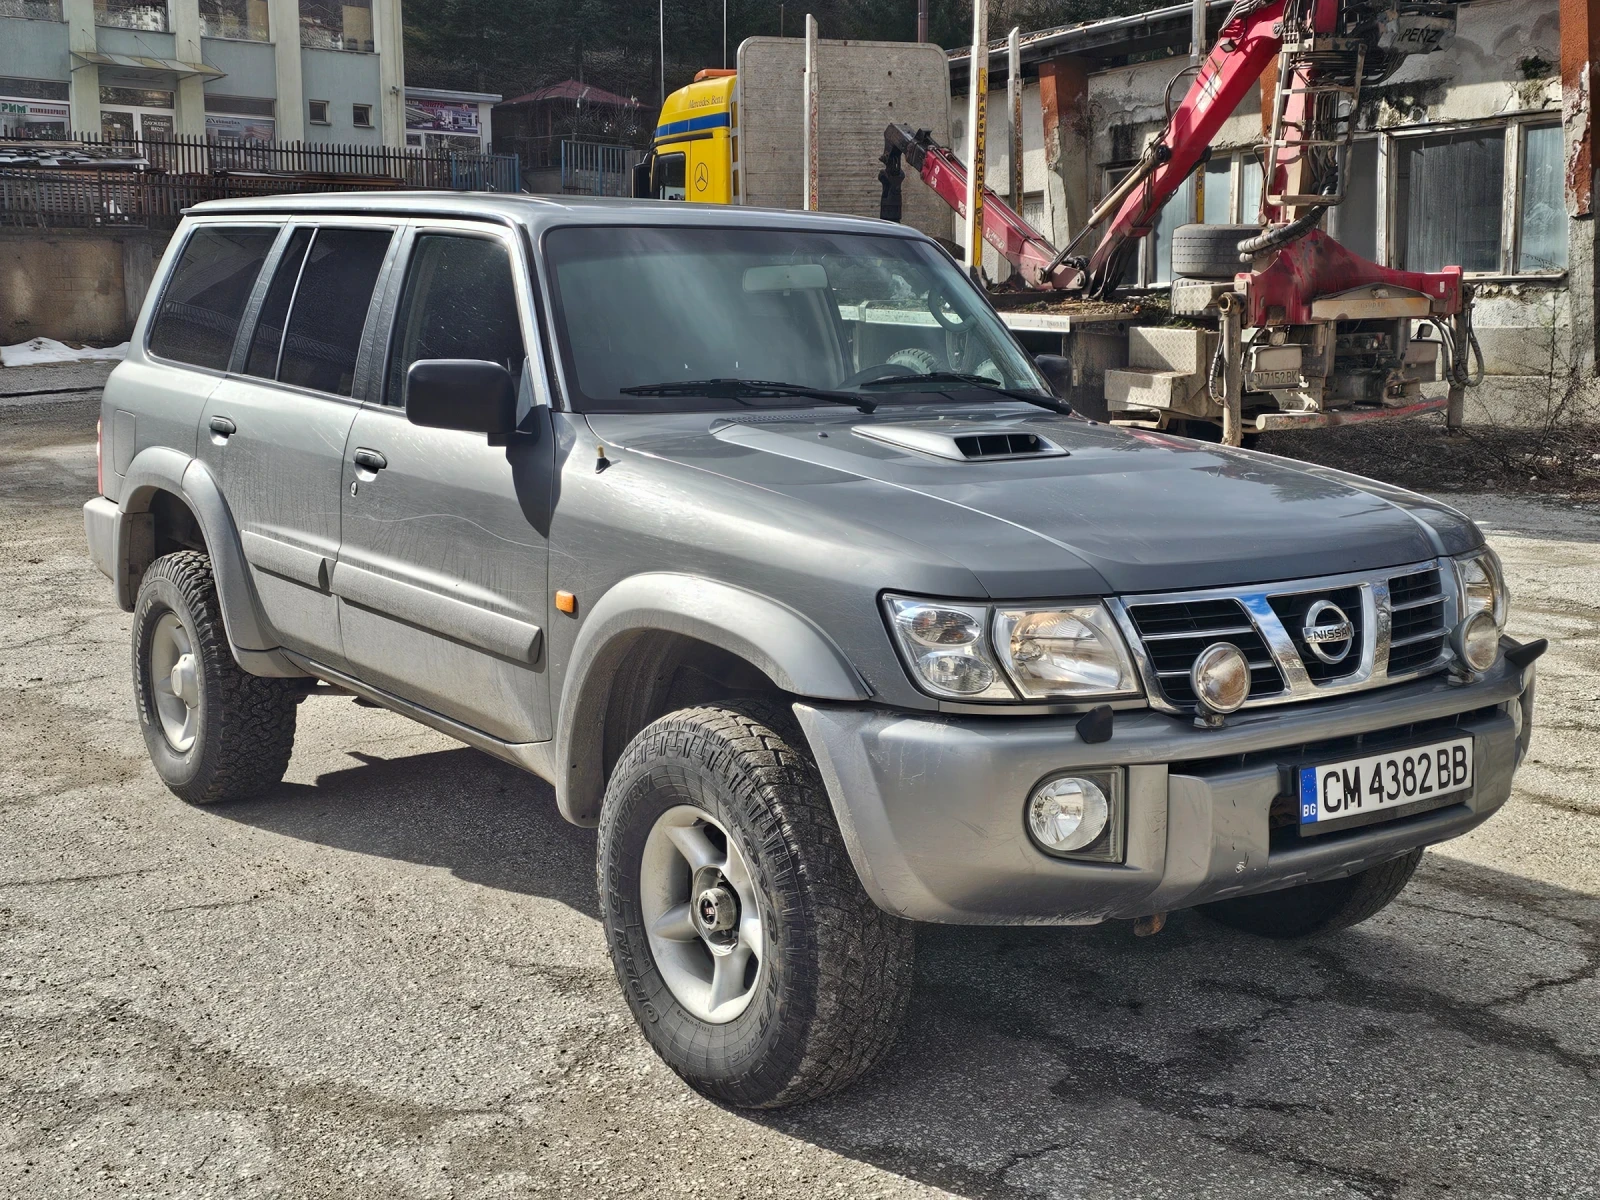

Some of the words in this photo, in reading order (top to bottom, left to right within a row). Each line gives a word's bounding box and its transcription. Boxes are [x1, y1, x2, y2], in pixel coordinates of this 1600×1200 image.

[1399, 26, 1441, 43] PENZ
[1323, 766, 1362, 813] CM
[1369, 753, 1433, 803] 4382
[1437, 745, 1468, 790] BB
[1303, 803, 1317, 817] BG
[608, 771, 654, 914] COUNTRY
